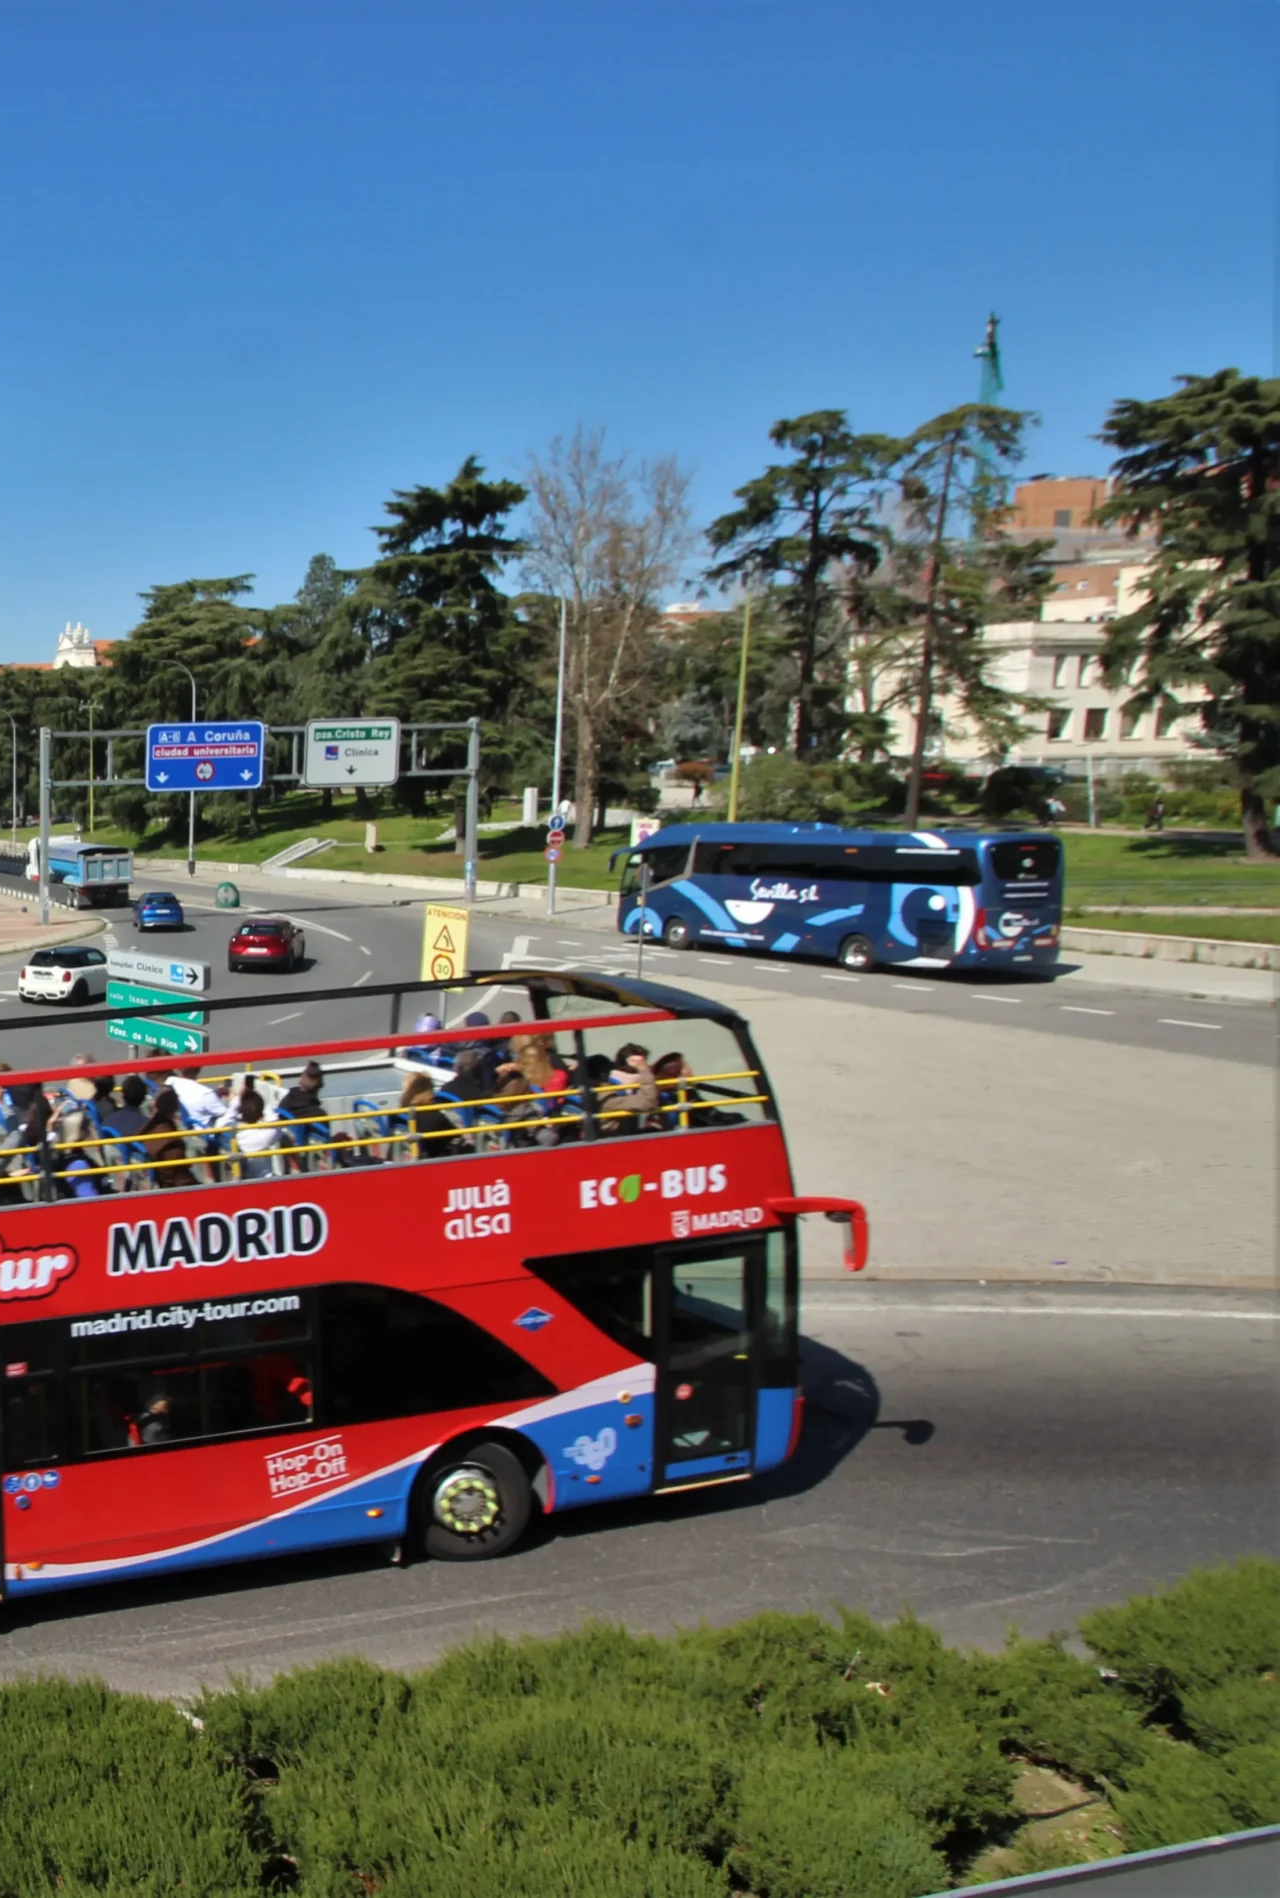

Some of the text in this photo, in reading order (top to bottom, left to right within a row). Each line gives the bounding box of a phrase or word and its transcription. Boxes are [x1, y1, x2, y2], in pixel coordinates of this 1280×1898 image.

[187, 731, 197, 742] A
[204, 729, 251, 742] Coruña
[371, 728, 390, 740] Rey
[155, 745, 254, 757] ciudad universitaria
[427, 908, 467, 921] ATENCIÓN
[436, 963, 449, 975] 30
[132, 1032, 142, 1041] de
[145, 1034, 157, 1044] los
[444, 1213, 511, 1241] alsa
[692, 1207, 764, 1230] MADRID
[107, 1203, 328, 1277] MADRID
[71, 1295, 300, 1338] madrid.city-tour.com
[267, 1444, 343, 1476] Hop-On
[269, 1456, 347, 1494] Hop-Off
